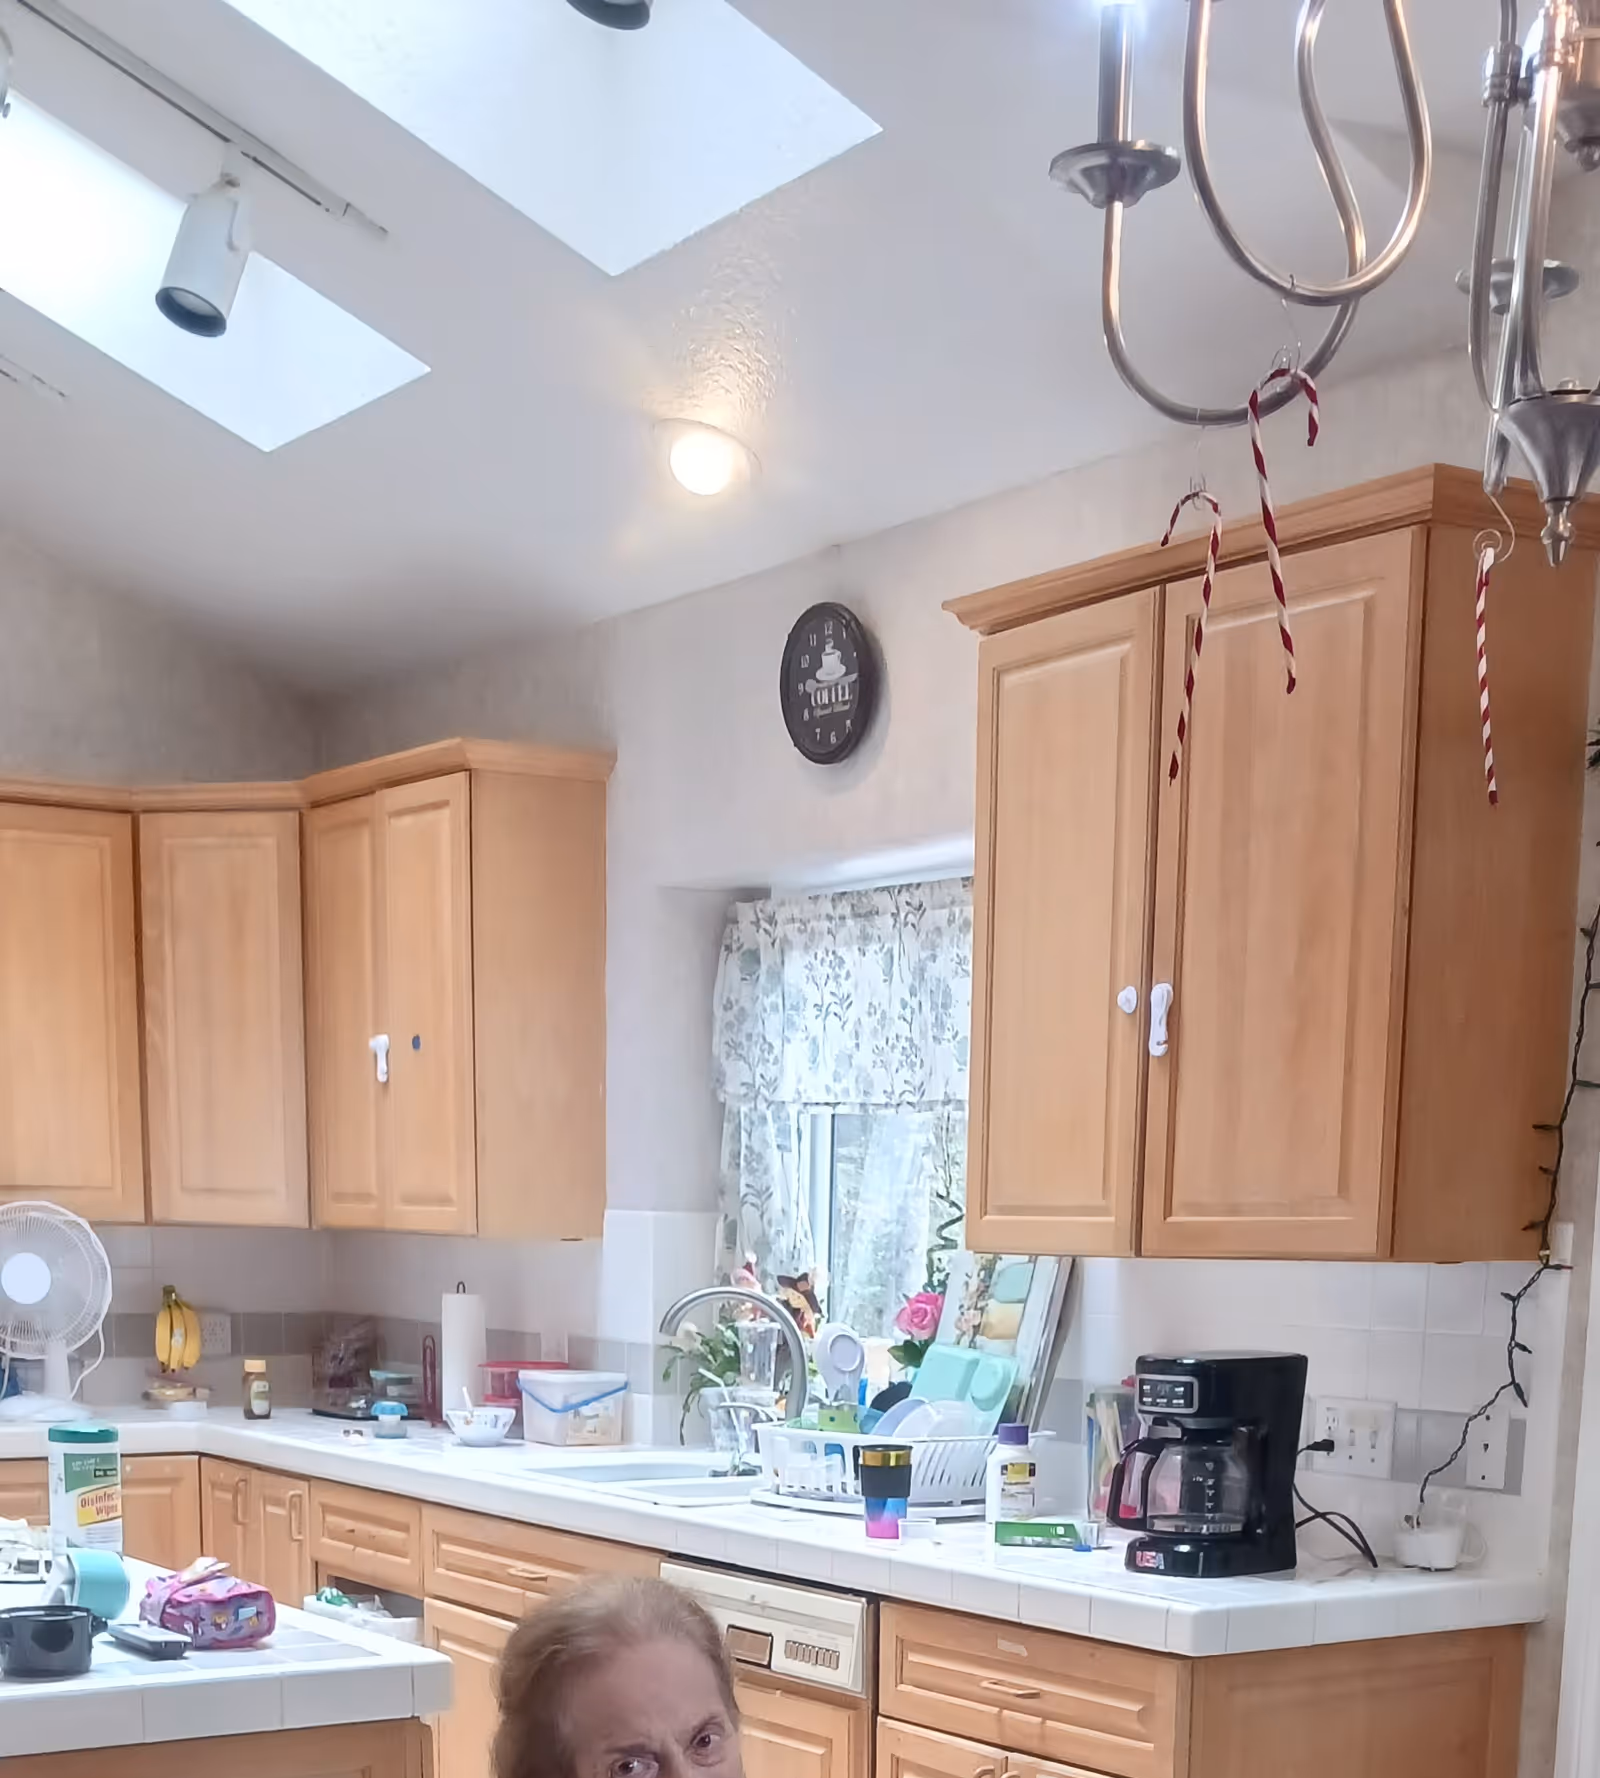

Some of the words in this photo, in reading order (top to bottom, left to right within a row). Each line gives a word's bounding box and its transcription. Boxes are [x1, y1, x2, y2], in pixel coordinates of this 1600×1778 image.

[824, 621, 833, 635] 12
[809, 633, 817, 647] 11
[801, 654, 810, 669] 10
[798, 683, 804, 697] 9
[810, 683, 853, 707] COFFEE
[815, 727, 821, 742] 7
[830, 731, 836, 745] 6
